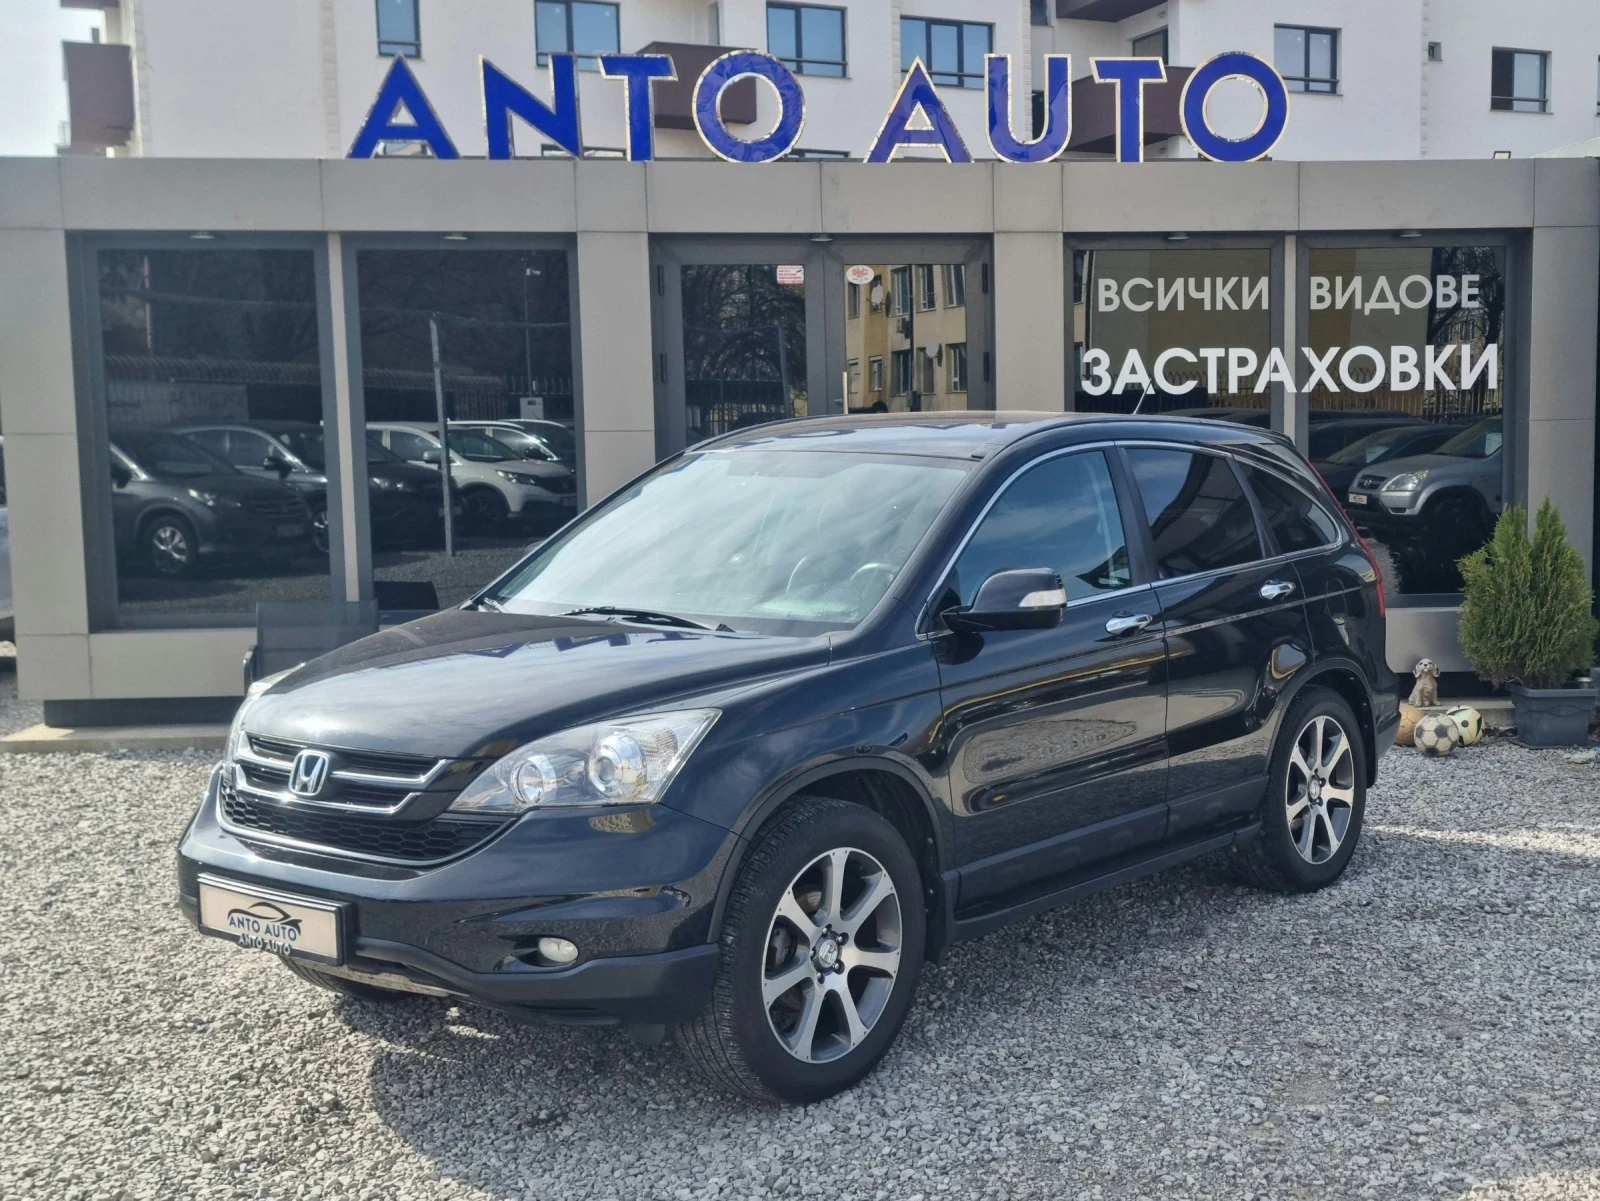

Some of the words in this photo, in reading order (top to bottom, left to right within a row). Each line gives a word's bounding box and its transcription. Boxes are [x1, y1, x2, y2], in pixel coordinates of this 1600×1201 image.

[346, 50, 806, 162] ANTO
[863, 51, 1290, 162] AUTO
[1097, 276, 1269, 312] ВСИЧКИ
[1309, 274, 1480, 315] ВИДОВЕ
[1081, 344, 1498, 396] ЗАСТРАХОВКИ
[229, 916, 261, 933] ANTO
[264, 924, 297, 941] AUTO
[238, 934, 263, 949] ANTO
[265, 940, 291, 956] AUTO
